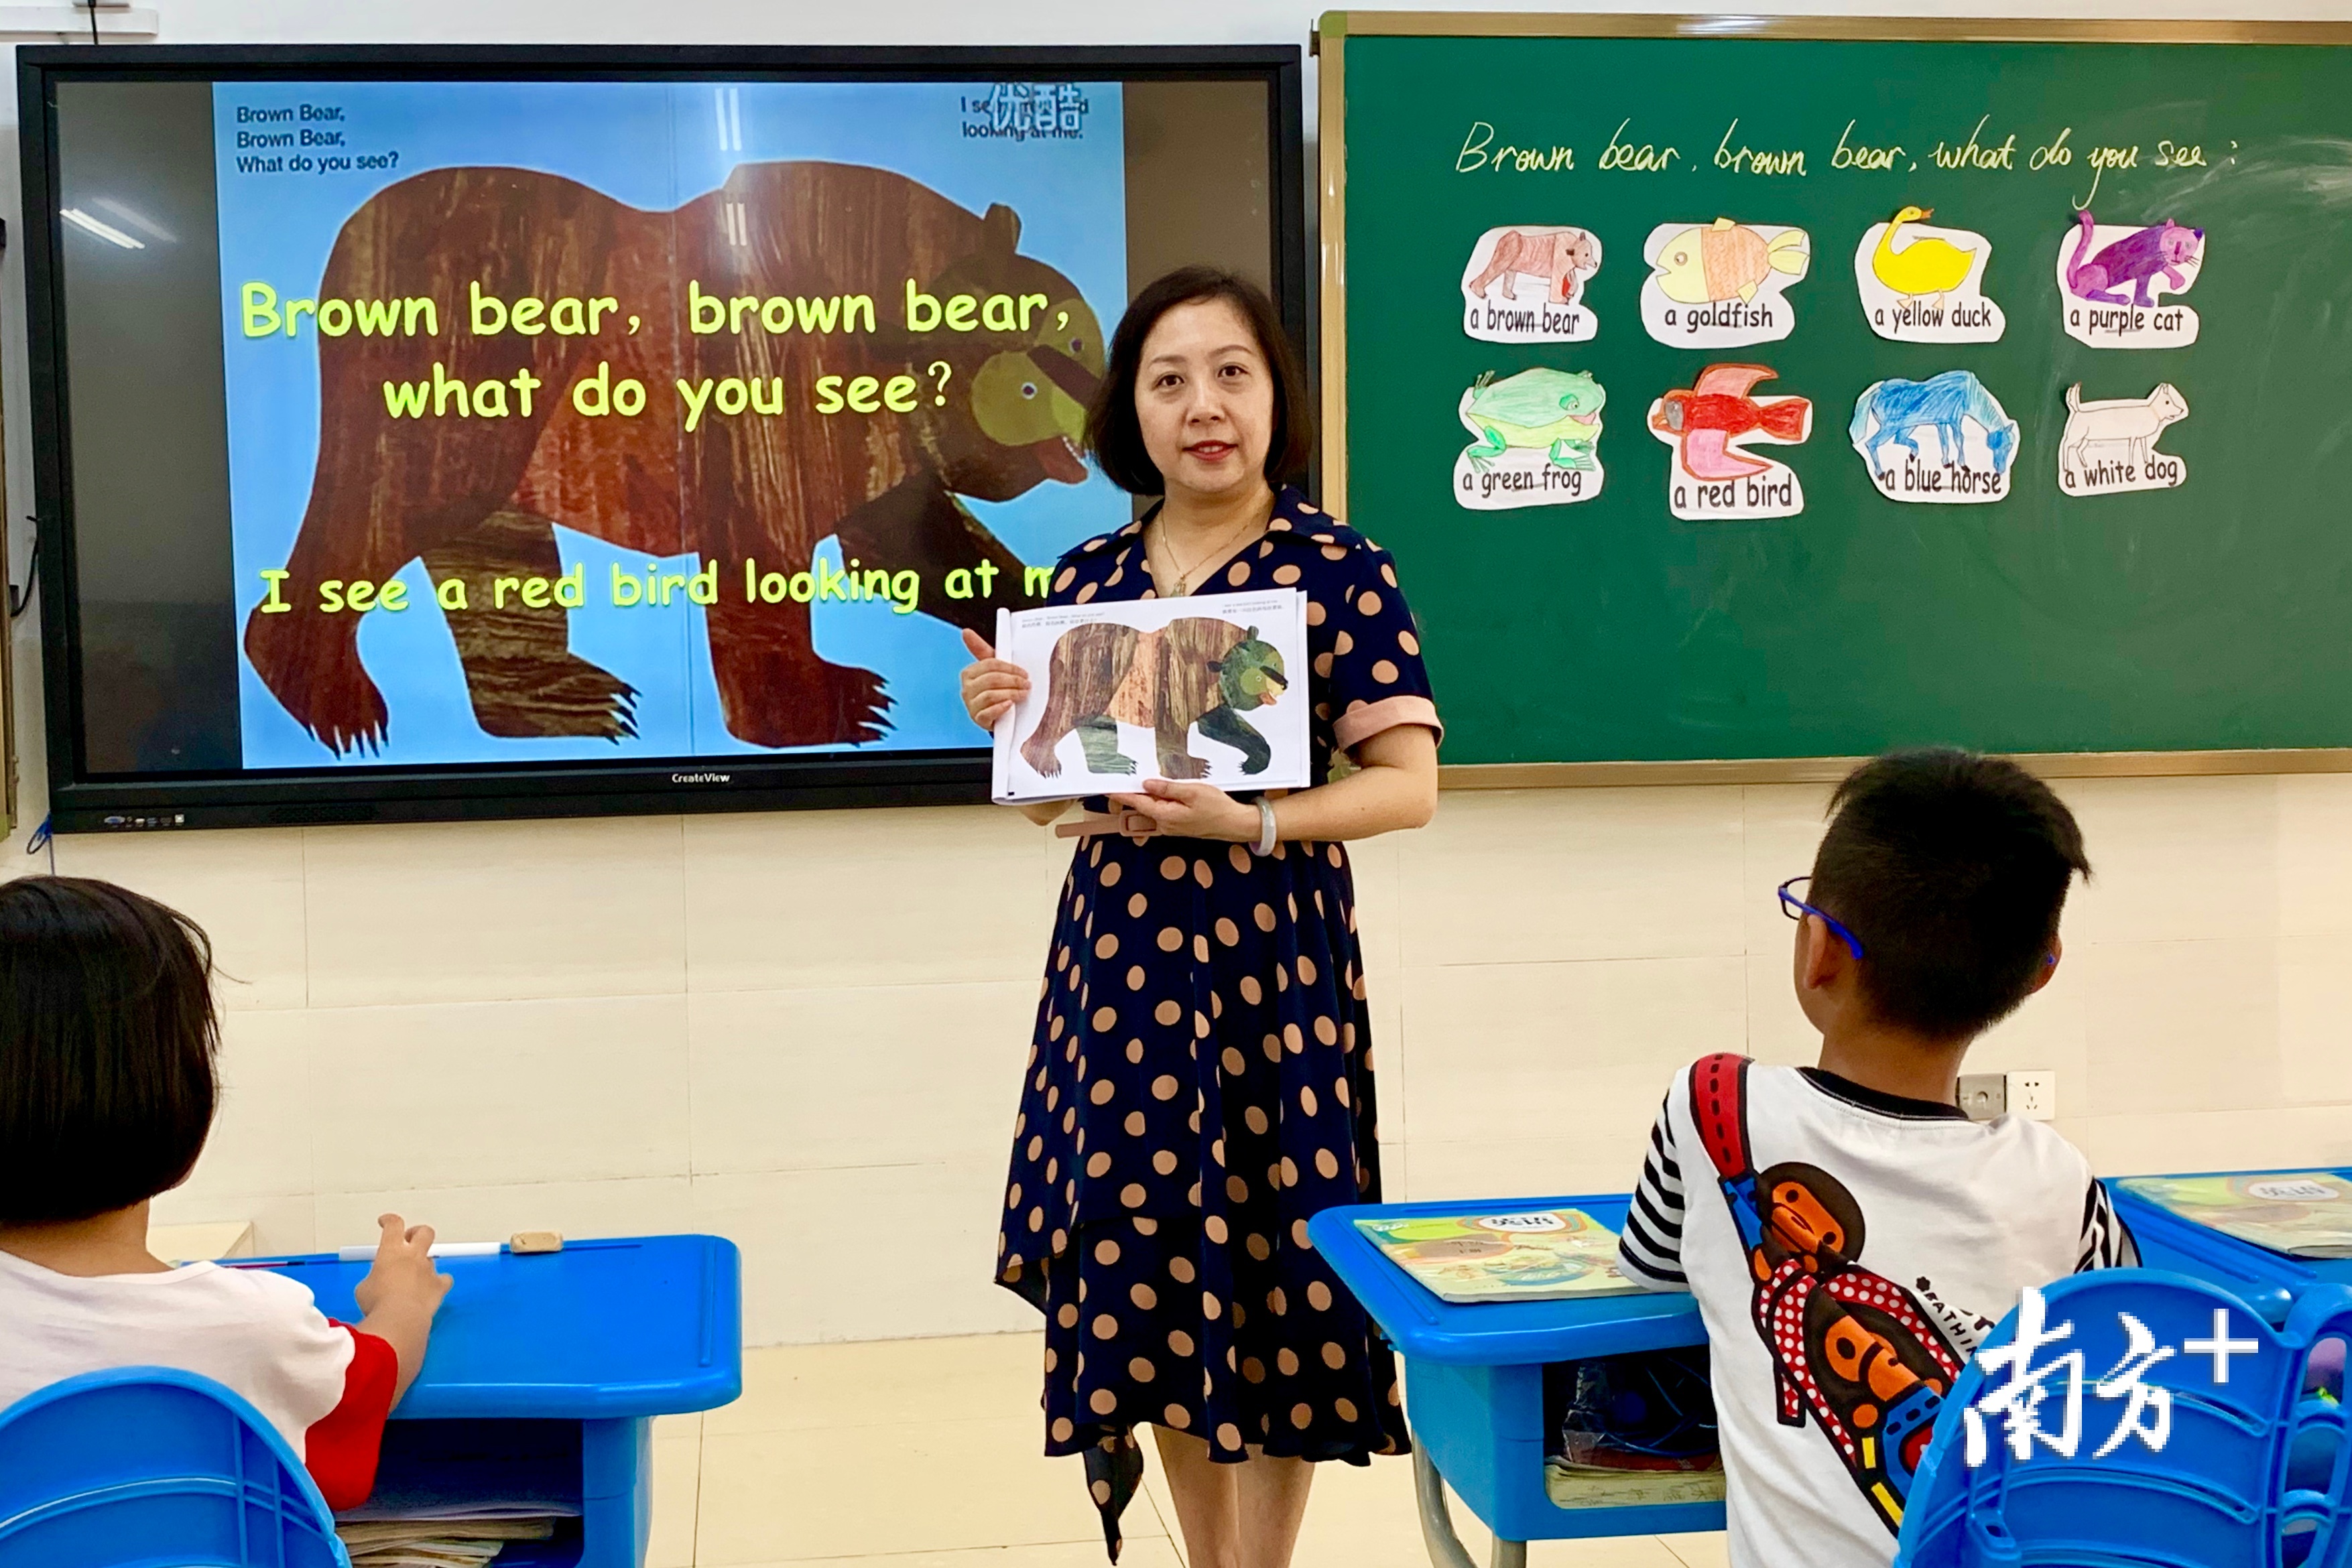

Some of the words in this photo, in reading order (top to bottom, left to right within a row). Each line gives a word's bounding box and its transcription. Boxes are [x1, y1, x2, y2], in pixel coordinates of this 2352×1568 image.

[237, 106, 294, 123] Brown
[989, 83, 1081, 131] 优酷
[237, 131, 294, 149] Brown
[237, 156, 284, 173] What
[289, 153, 313, 172] do
[317, 156, 351, 176] you
[356, 150, 399, 170] see?
[1455, 121, 1575, 173] Brown
[1713, 117, 1807, 176] brown
[1830, 119, 1918, 172] bear,
[1928, 114, 2016, 171] what
[2028, 127, 2072, 171] do
[2072, 145, 2138, 210] you
[240, 281, 440, 338] Brown
[470, 279, 642, 336] bear,
[688, 279, 877, 334] brown
[906, 277, 1070, 332] bear,
[1470, 307, 1479, 330] a
[1487, 300, 1535, 332] brown
[1542, 302, 1580, 335] bear
[1664, 308, 1677, 327] a
[1686, 302, 1774, 333] goldfish
[1875, 307, 1884, 327] a
[1892, 300, 1944, 334] yellow
[1951, 301, 1992, 328] duck
[2070, 310, 2079, 327] a
[2089, 304, 2146, 337] purple
[2153, 304, 2184, 332] cat
[382, 362, 542, 419] what
[572, 361, 647, 417] do
[675, 376, 784, 433] you
[814, 360, 952, 416] see?
[1463, 471, 1473, 491] a
[1481, 470, 1534, 499] green
[1542, 462, 1583, 497] frog
[1885, 468, 1896, 491] a
[1904, 458, 1942, 491] blue
[1951, 466, 2002, 495] horse
[2064, 469, 2077, 489] a
[2083, 460, 2136, 488] white
[2145, 454, 2178, 486] dog
[1674, 485, 1687, 509] a
[1697, 480, 1735, 508] red
[1746, 472, 1792, 507] bird
[259, 569, 292, 614] I
[319, 579, 410, 612] see
[437, 578, 468, 610] a
[494, 562, 585, 609] red
[611, 558, 719, 607] bird
[745, 556, 920, 614] looking
[944, 558, 1000, 600] at
[1024, 566, 1056, 600] m
[672, 773, 731, 783] CreateView
